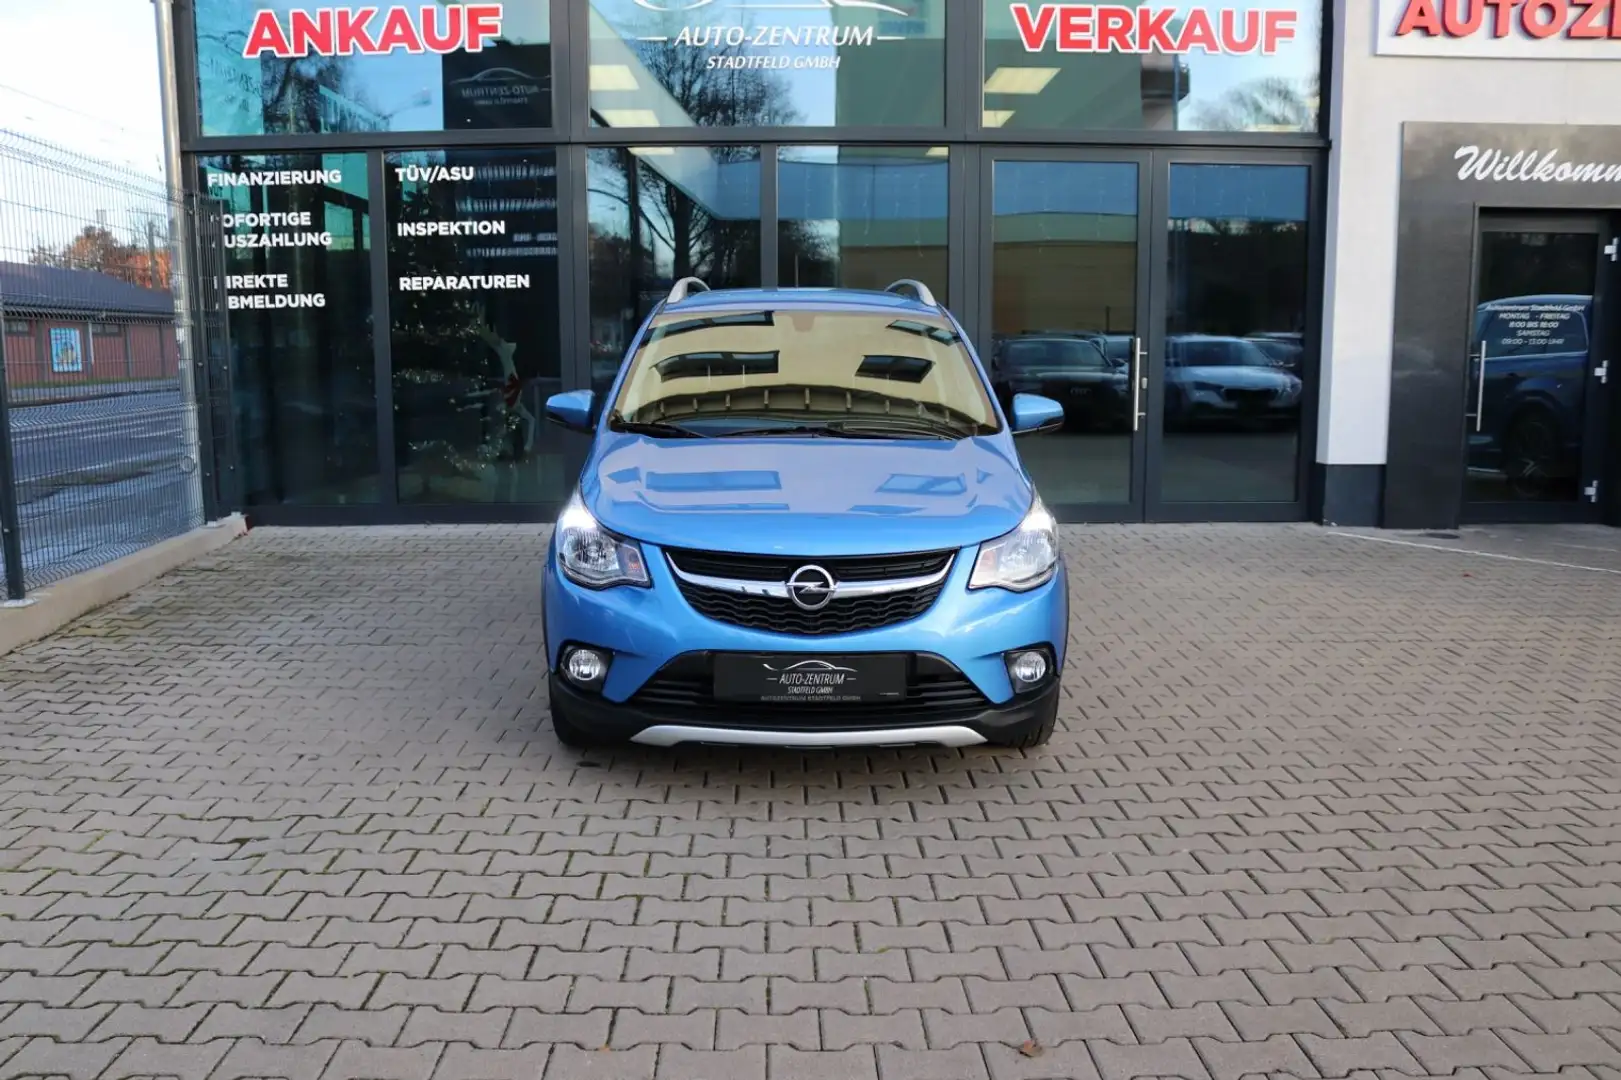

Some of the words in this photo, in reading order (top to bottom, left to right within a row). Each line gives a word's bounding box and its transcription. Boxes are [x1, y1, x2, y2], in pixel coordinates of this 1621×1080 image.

[1396, 0, 1621, 38] AUTOZ
[244, 5, 502, 58] ANKAUF
[674, 26, 873, 47] AUTO-ZENTRUM
[1010, 4, 1299, 56] VERKAUF
[706, 55, 790, 70] STADTFELD
[793, 56, 841, 70] GMBH
[207, 169, 342, 187] FINANZIERUNG
[395, 166, 475, 183] TÜV/ASU
[397, 220, 506, 237] INSPEKTION
[212, 231, 333, 249] USZAHLUNG
[399, 274, 531, 291] REPARATUREN
[215, 293, 326, 310] BMELDUNG
[779, 673, 845, 685] AUTO-ZENTRUM
[787, 685, 815, 694] STADTFELD
